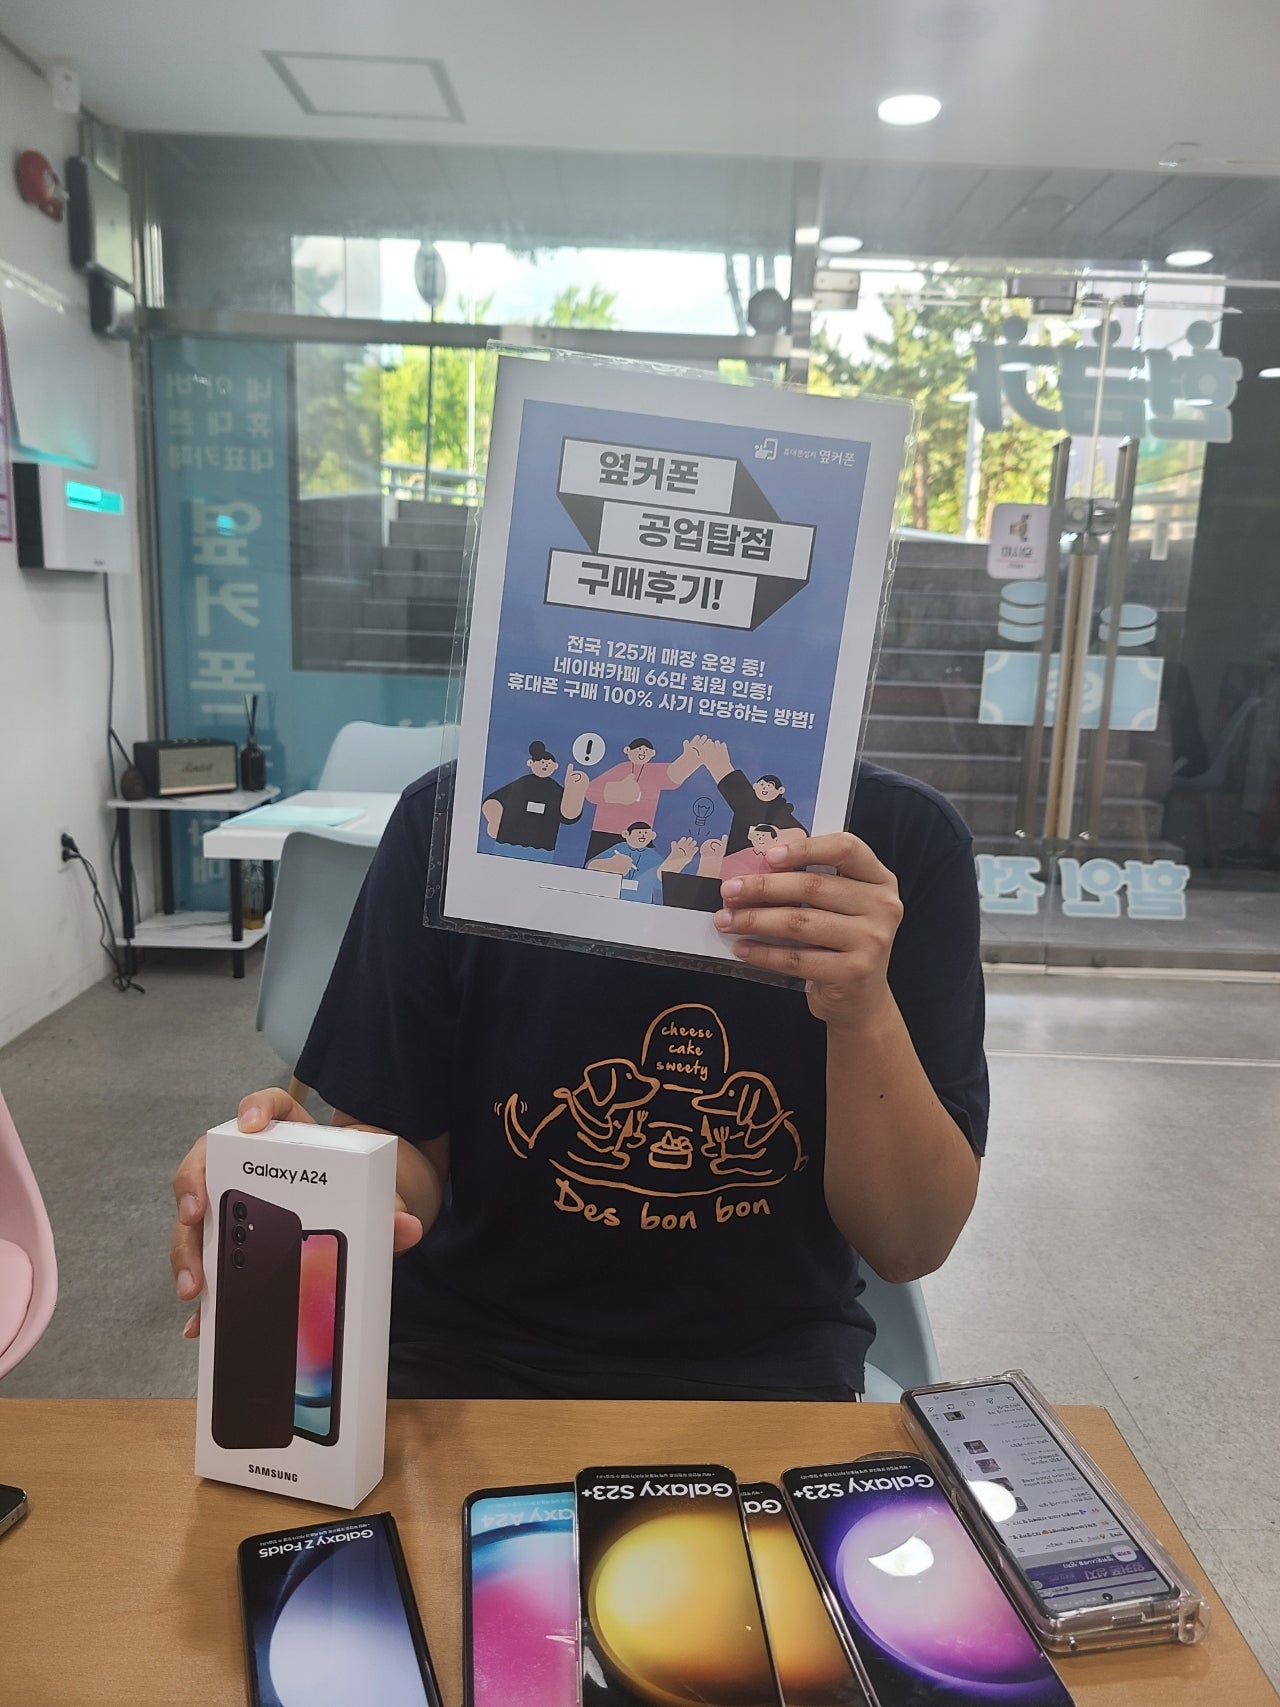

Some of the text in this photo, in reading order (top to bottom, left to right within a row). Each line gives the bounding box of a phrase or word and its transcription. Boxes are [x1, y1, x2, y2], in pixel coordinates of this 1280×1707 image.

[818, 448, 857, 467] 옆커폰
[598, 450, 700, 496] 옆커폰
[637, 512, 775, 562] 공업탑점
[577, 561, 724, 611] 구매후기!
[566, 635, 766, 678] 전국 125개 매장 운영 중!
[553, 655, 773, 702] 네이버카페 66만 회원 인증!
[507, 671, 816, 730] 휴대폰 구매 100% 사기 안당하는 방법!
[660, 1021, 713, 1040] cheese
[668, 1039, 704, 1058] cake
[656, 1059, 709, 1080] sweety
[242, 1160, 329, 1186] Galaxy A24
[553, 1177, 771, 1230] Des bon bon
[248, 1463, 299, 1483] SAMSUNG
[581, 1483, 634, 1500] S23+
[639, 1481, 733, 1499] Galaxy
[791, 1482, 845, 1501] S23+
[848, 1472, 935, 1495] Galaxy
[528, 1507, 574, 1524] axy
[303, 1538, 315, 1550] Z
[315, 1528, 374, 1547] Galaxy
[258, 1541, 302, 1558] Fold5
